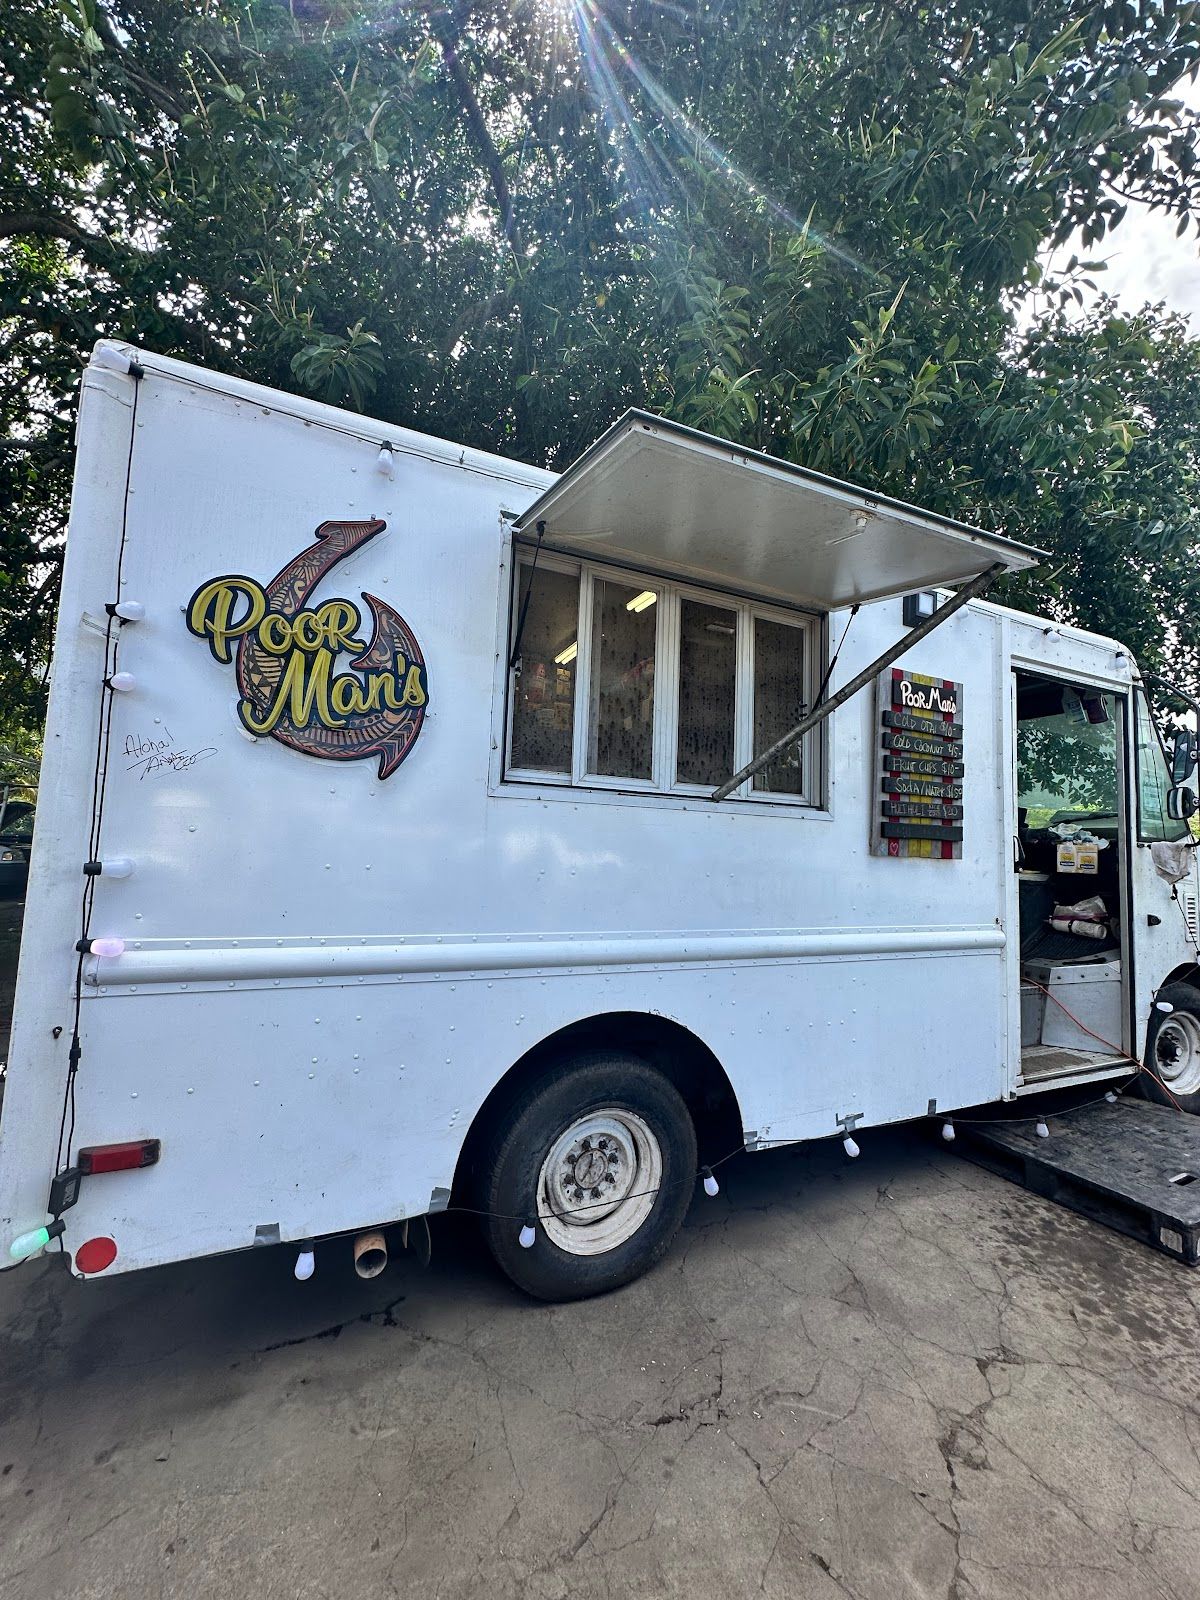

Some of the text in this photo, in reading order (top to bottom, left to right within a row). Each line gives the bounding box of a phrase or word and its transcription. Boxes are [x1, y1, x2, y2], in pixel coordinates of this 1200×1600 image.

[240, 647, 428, 734] Man's
[926, 687, 956, 714] Man's
[893, 734, 911, 748] COLD
[914, 739, 944, 754] COCONUT
